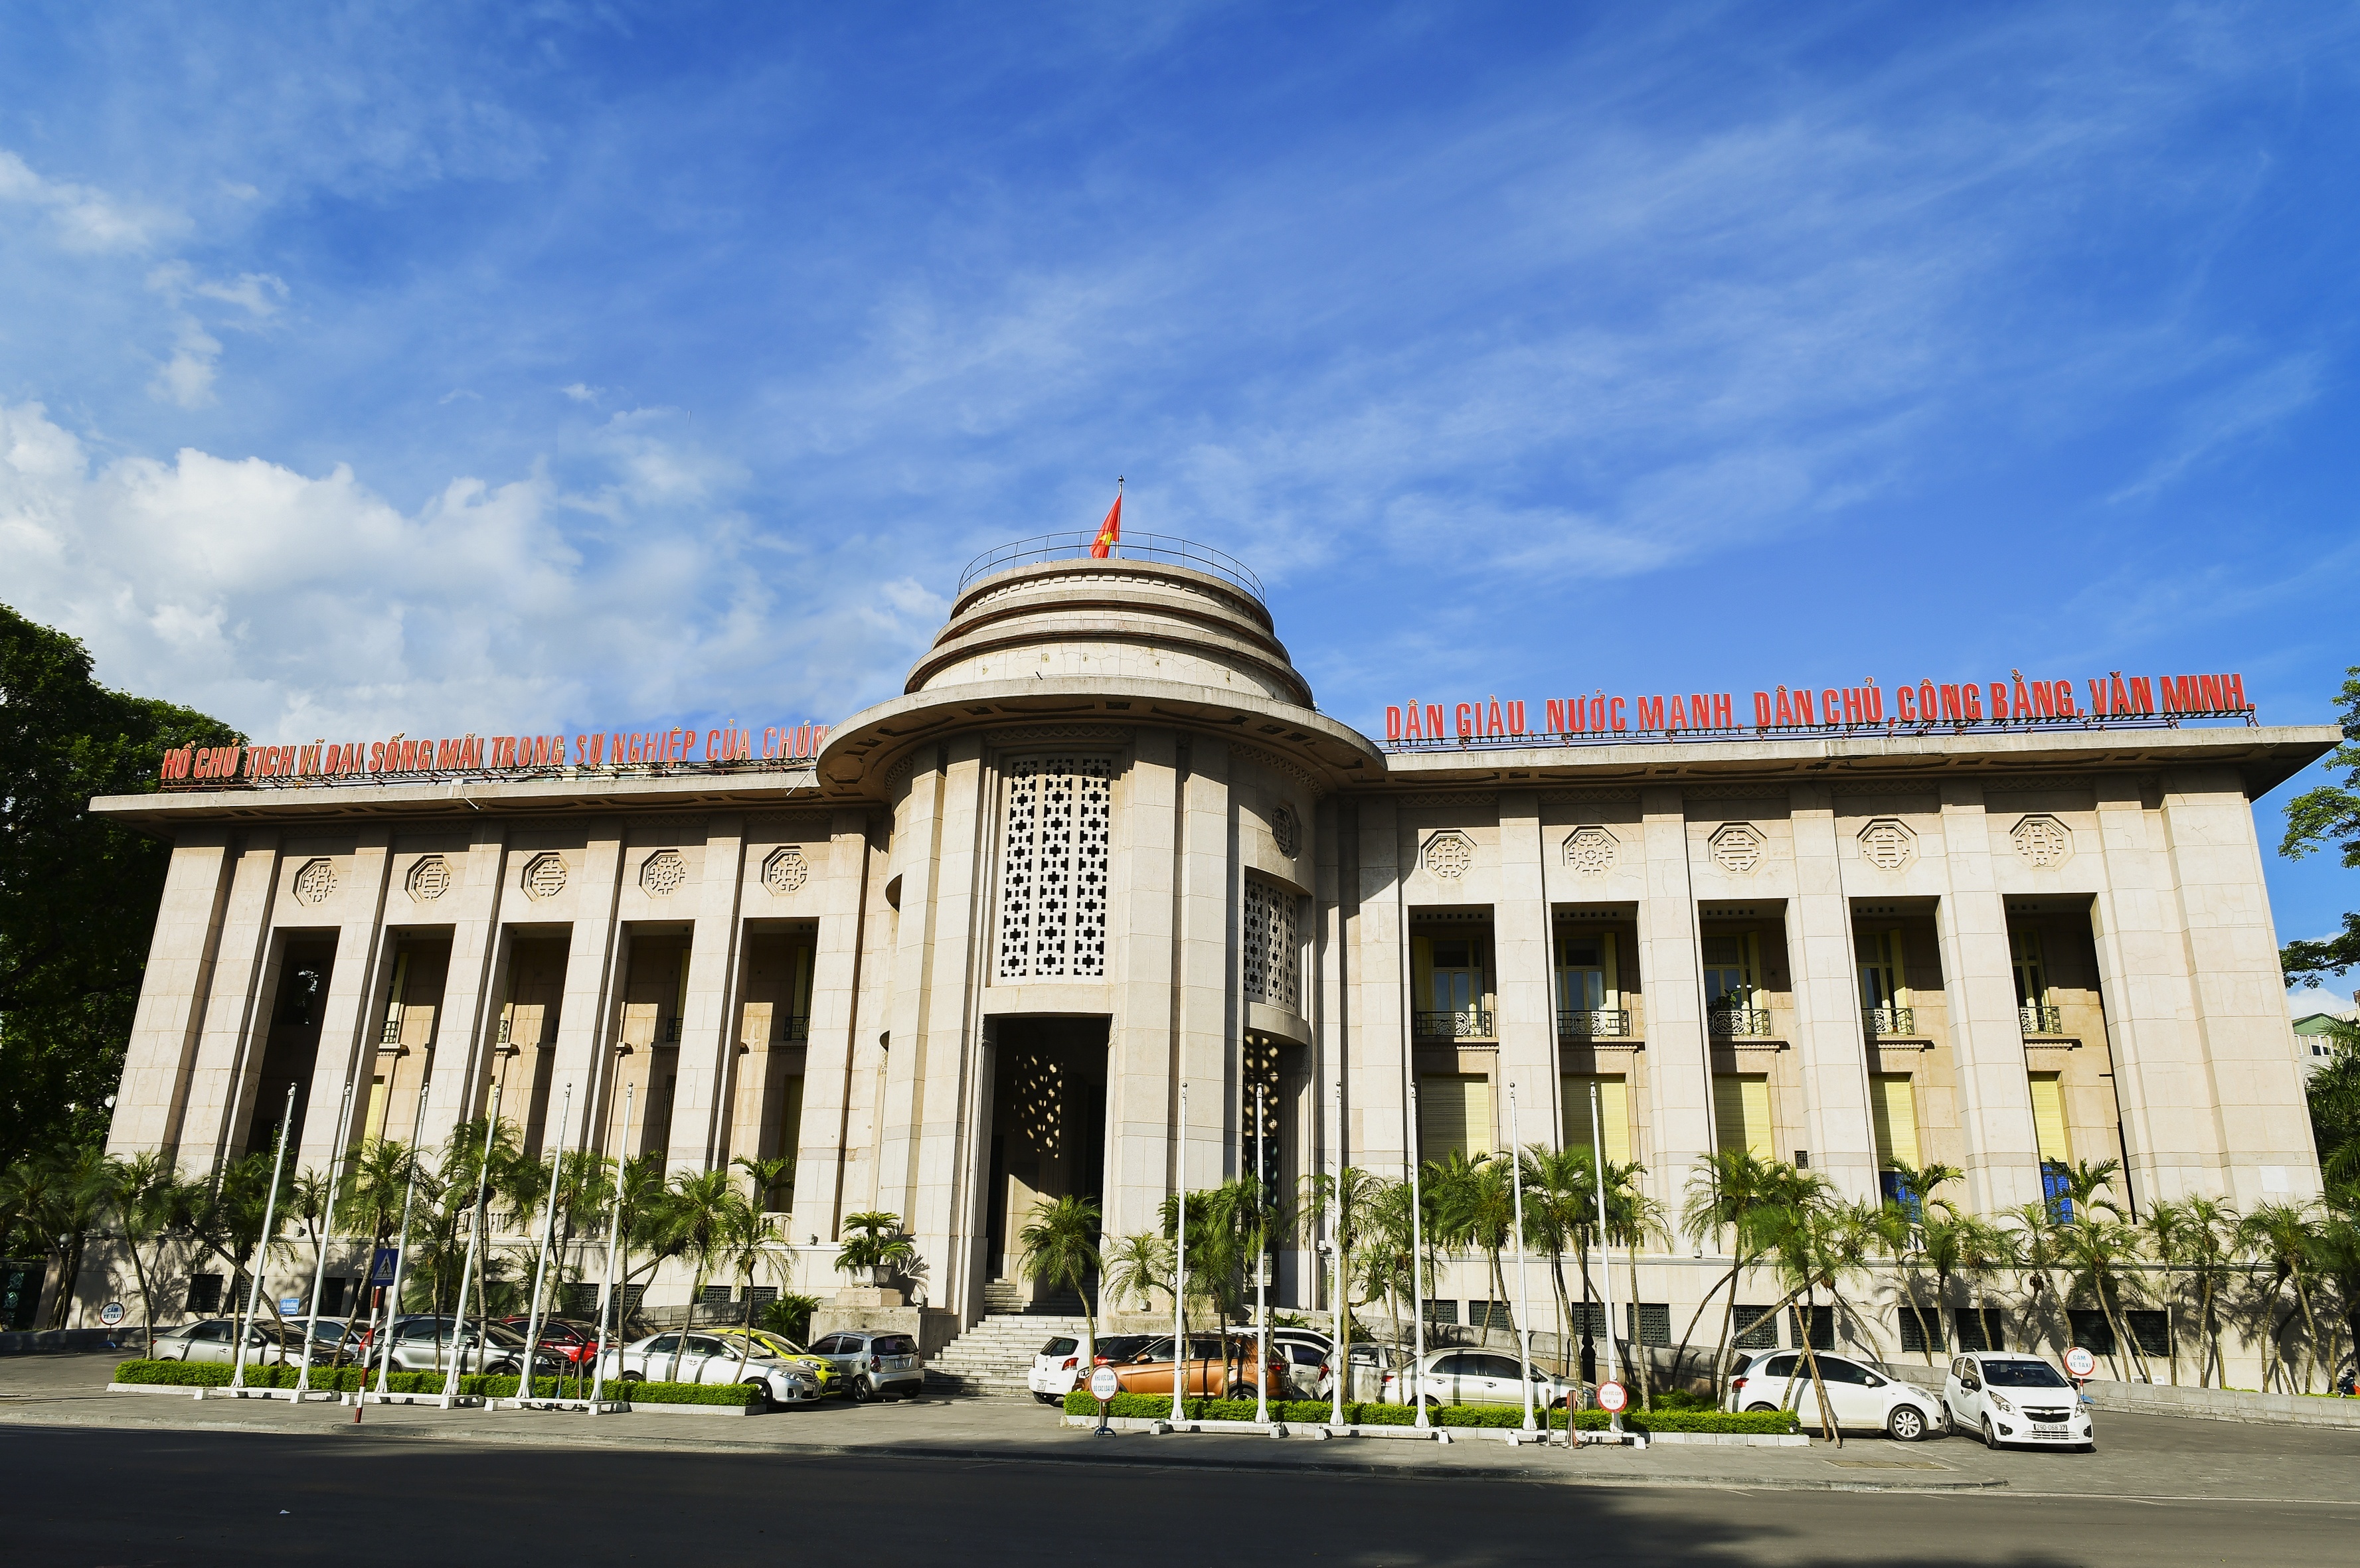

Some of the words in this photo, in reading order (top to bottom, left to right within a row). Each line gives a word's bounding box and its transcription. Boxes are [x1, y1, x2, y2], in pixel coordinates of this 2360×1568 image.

[1385, 698, 1445, 740] DÂN
[1456, 694, 1534, 737] GIÀU,
[1545, 688, 1627, 734] NƯỚC
[1753, 684, 1815, 727] DÂN
[1896, 678, 1983, 722] CÔNG
[1989, 668, 2086, 720] BẰNG,
[2088, 670, 2155, 716] VĂN
[160, 740, 195, 779] HỒ
[193, 738, 240, 779] CHỦ
[243, 745, 296, 783] TỊCH
[297, 738, 325, 775] VĨ
[324, 742, 365, 779] ĐẠI
[367, 732, 434, 772] SỐNG
[435, 733, 485, 769] MÃI
[490, 735, 566, 768] TRONG
[573, 730, 606, 770] SỰ
[610, 726, 697, 768] NGHIỆP
[705, 718, 752, 761] CỦA
